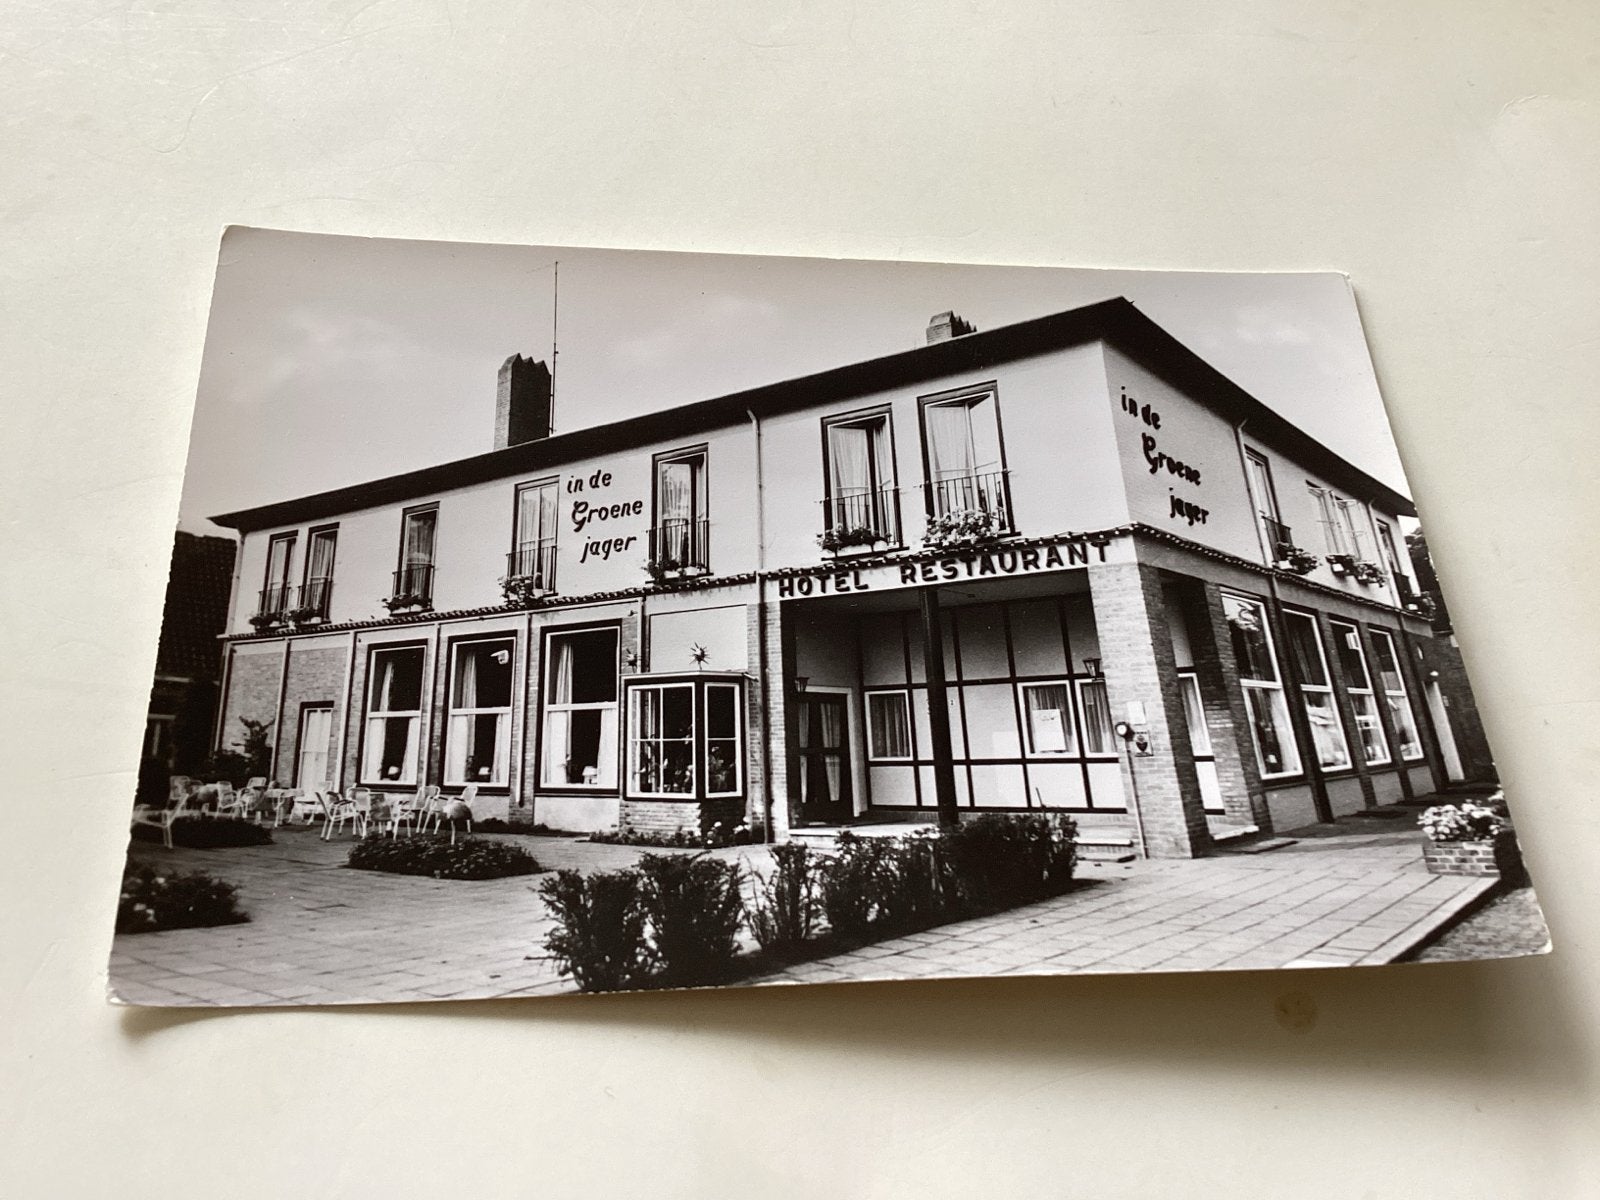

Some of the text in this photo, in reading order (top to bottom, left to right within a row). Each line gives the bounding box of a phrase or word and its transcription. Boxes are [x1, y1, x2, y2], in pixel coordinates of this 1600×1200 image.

[1121, 386, 1161, 430] in de
[1141, 432, 1201, 486] Groene
[567, 469, 612, 494] in de
[571, 500, 643, 533] Groene
[1169, 487, 1209, 526] jager
[580, 536, 637, 564] jager
[778, 540, 1111, 598] HOTEL RESTAURANT
